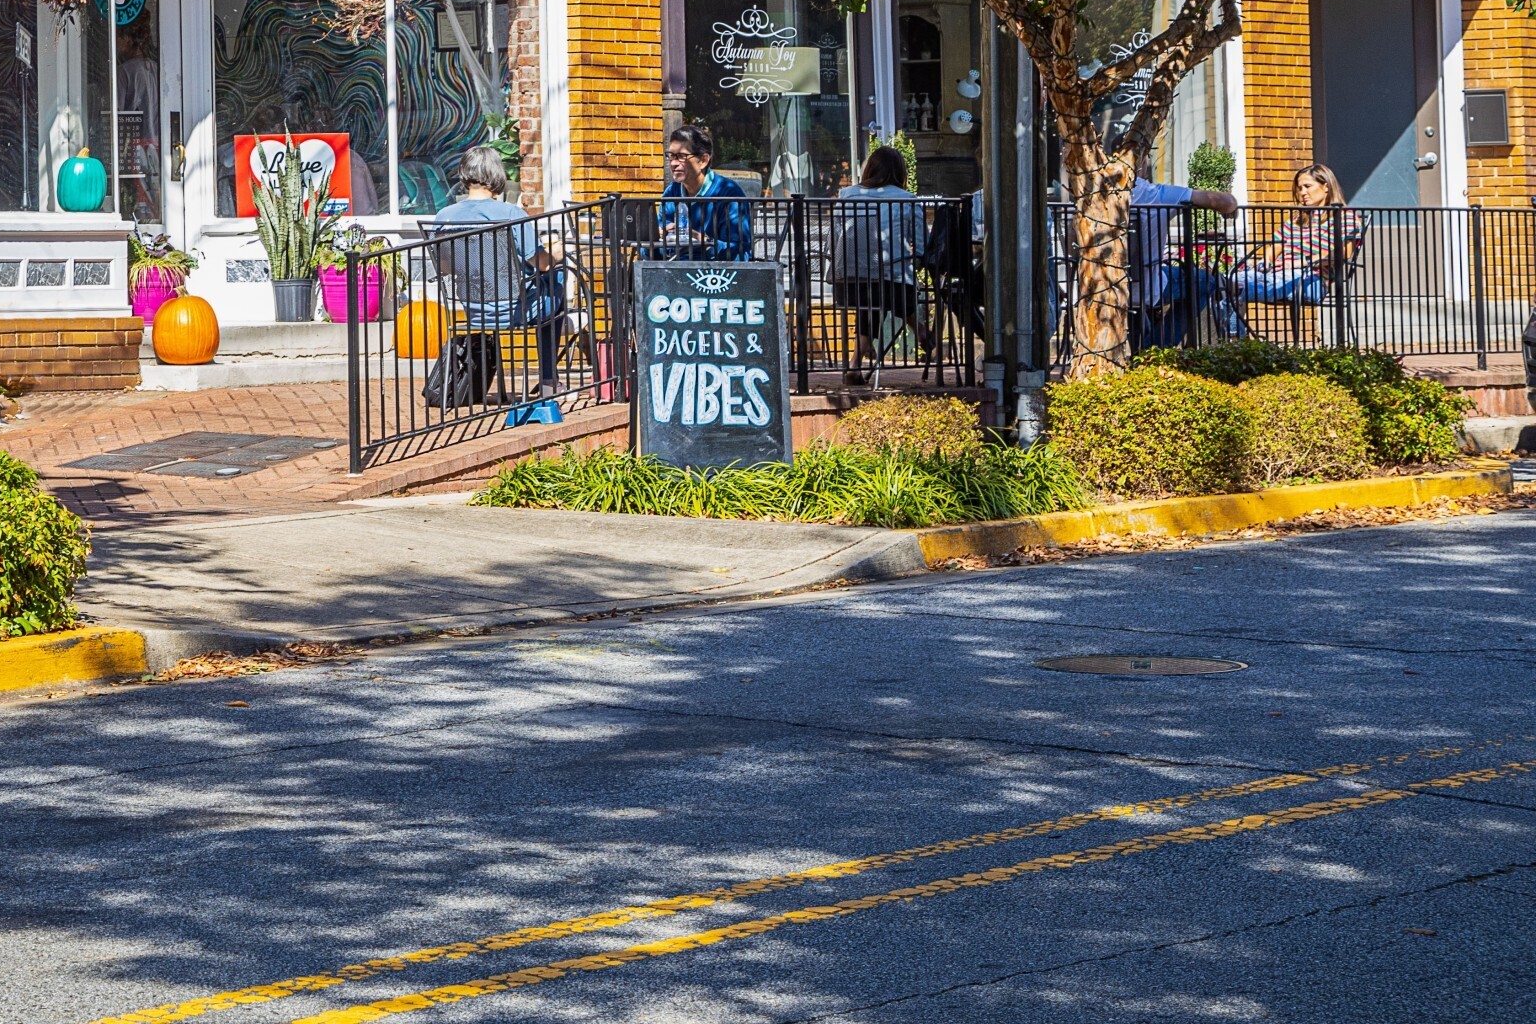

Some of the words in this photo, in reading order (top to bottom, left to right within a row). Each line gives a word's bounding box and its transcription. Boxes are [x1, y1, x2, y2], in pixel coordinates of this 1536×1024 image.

[712, 30, 765, 63] Autumn
[769, 40, 796, 69] Joy
[743, 63, 770, 73] SALON
[262, 151, 323, 173] Lve
[647, 295, 765, 325] COFFEE
[654, 327, 739, 358] BAGELS
[746, 332, 763, 355] &
[650, 362, 771, 426] VIBES
